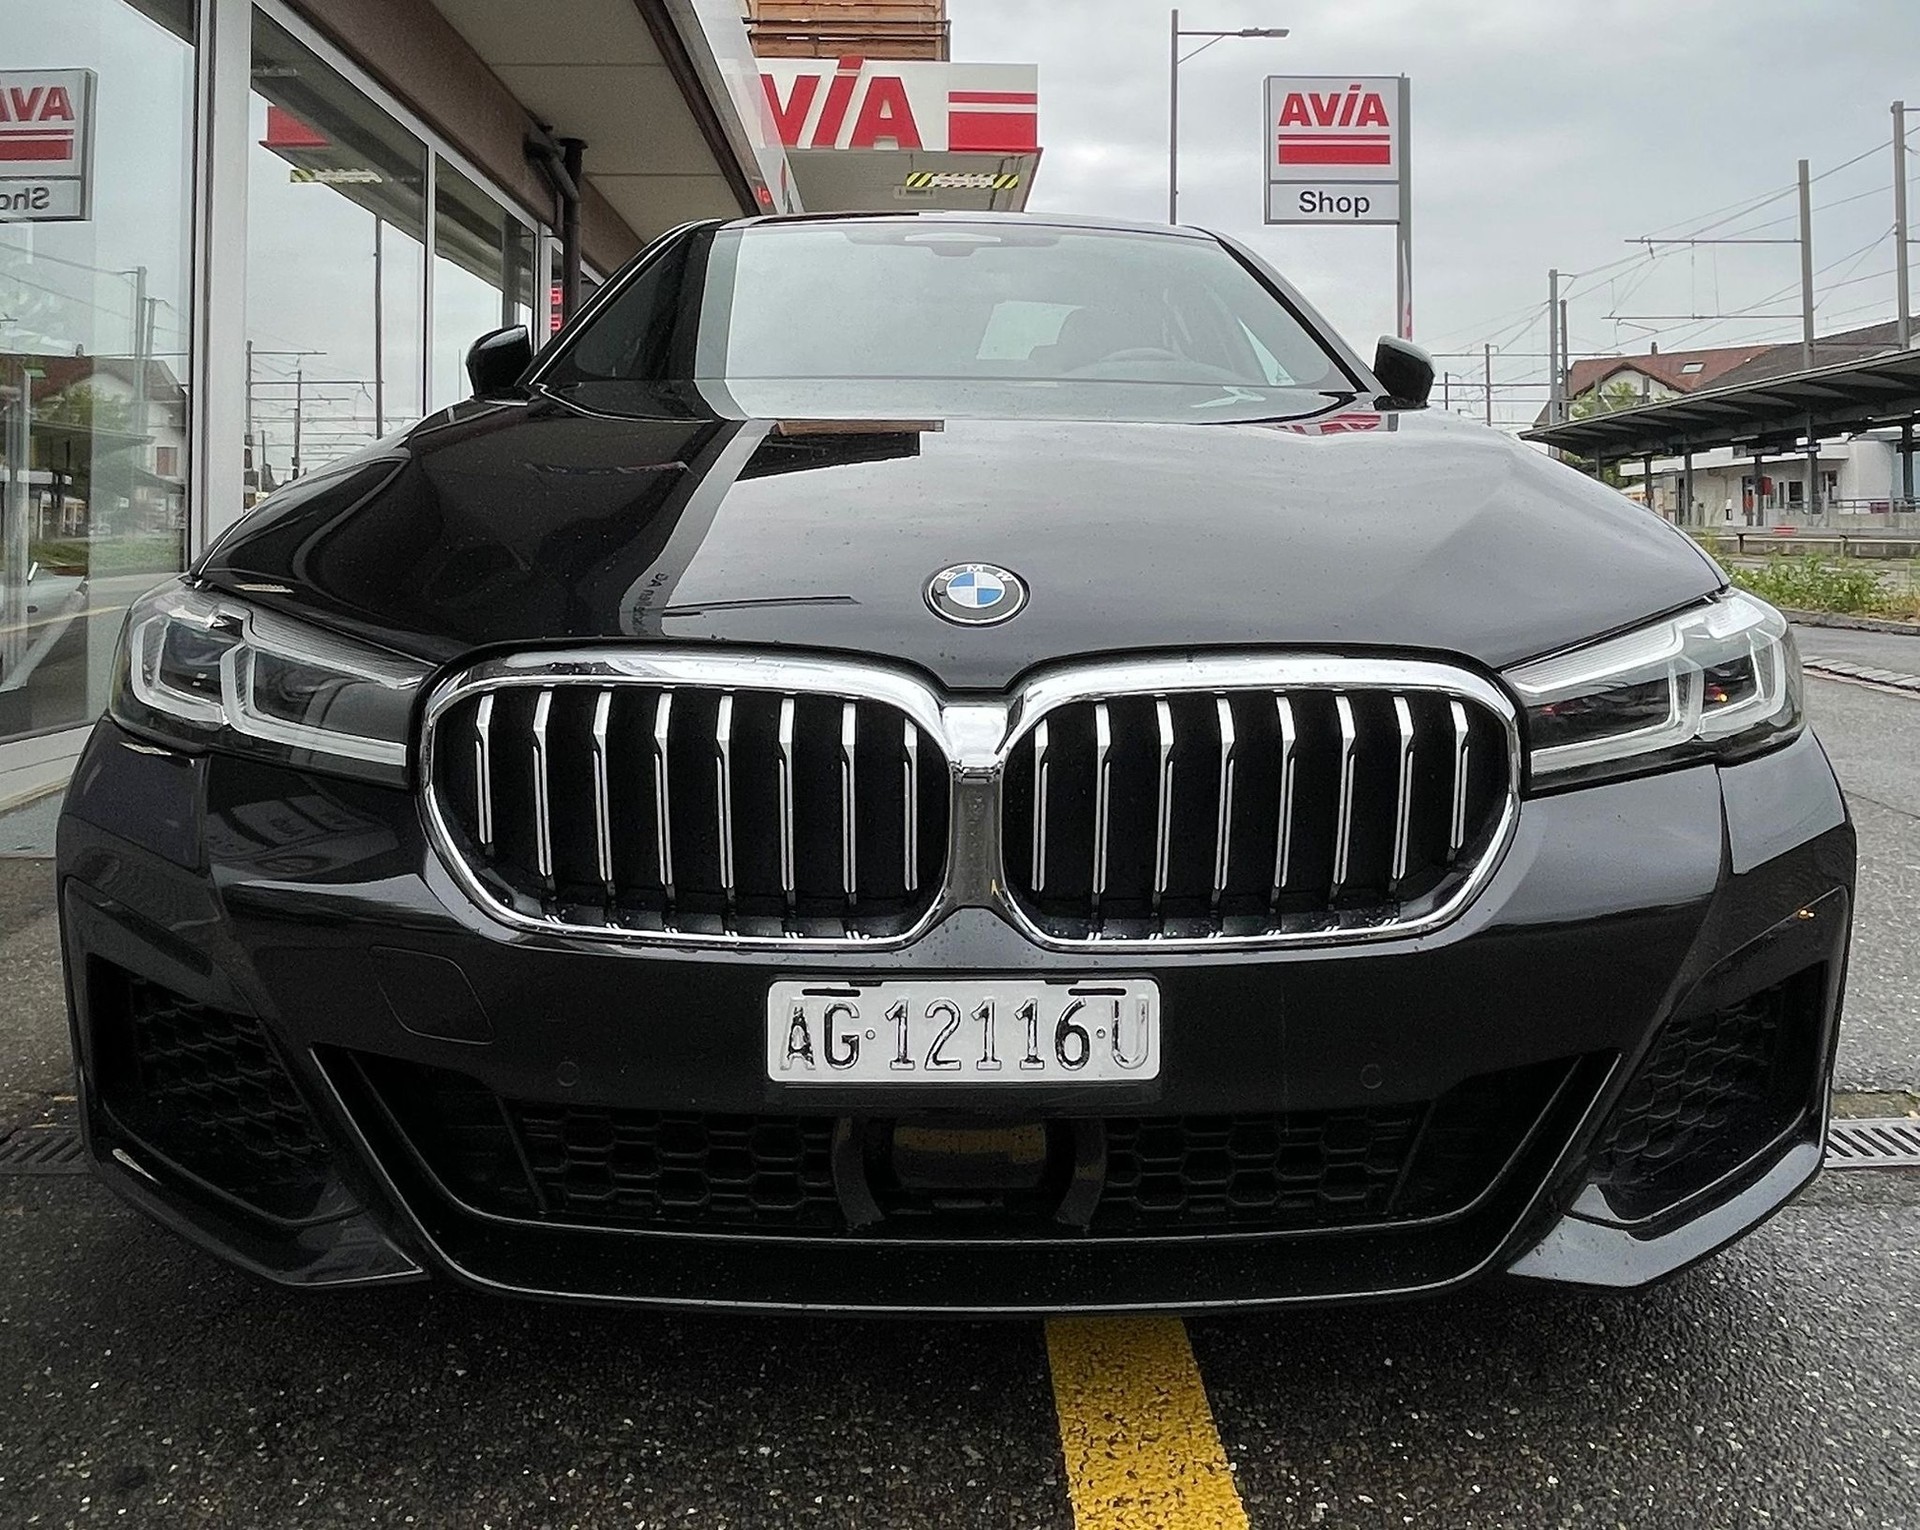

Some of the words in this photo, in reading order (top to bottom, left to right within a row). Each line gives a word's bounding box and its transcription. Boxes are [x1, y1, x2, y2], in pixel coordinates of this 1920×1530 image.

[1278, 84, 1390, 126] AVIA
[1299, 191, 1370, 217] Shop
[939, 565, 1014, 581] BMW
